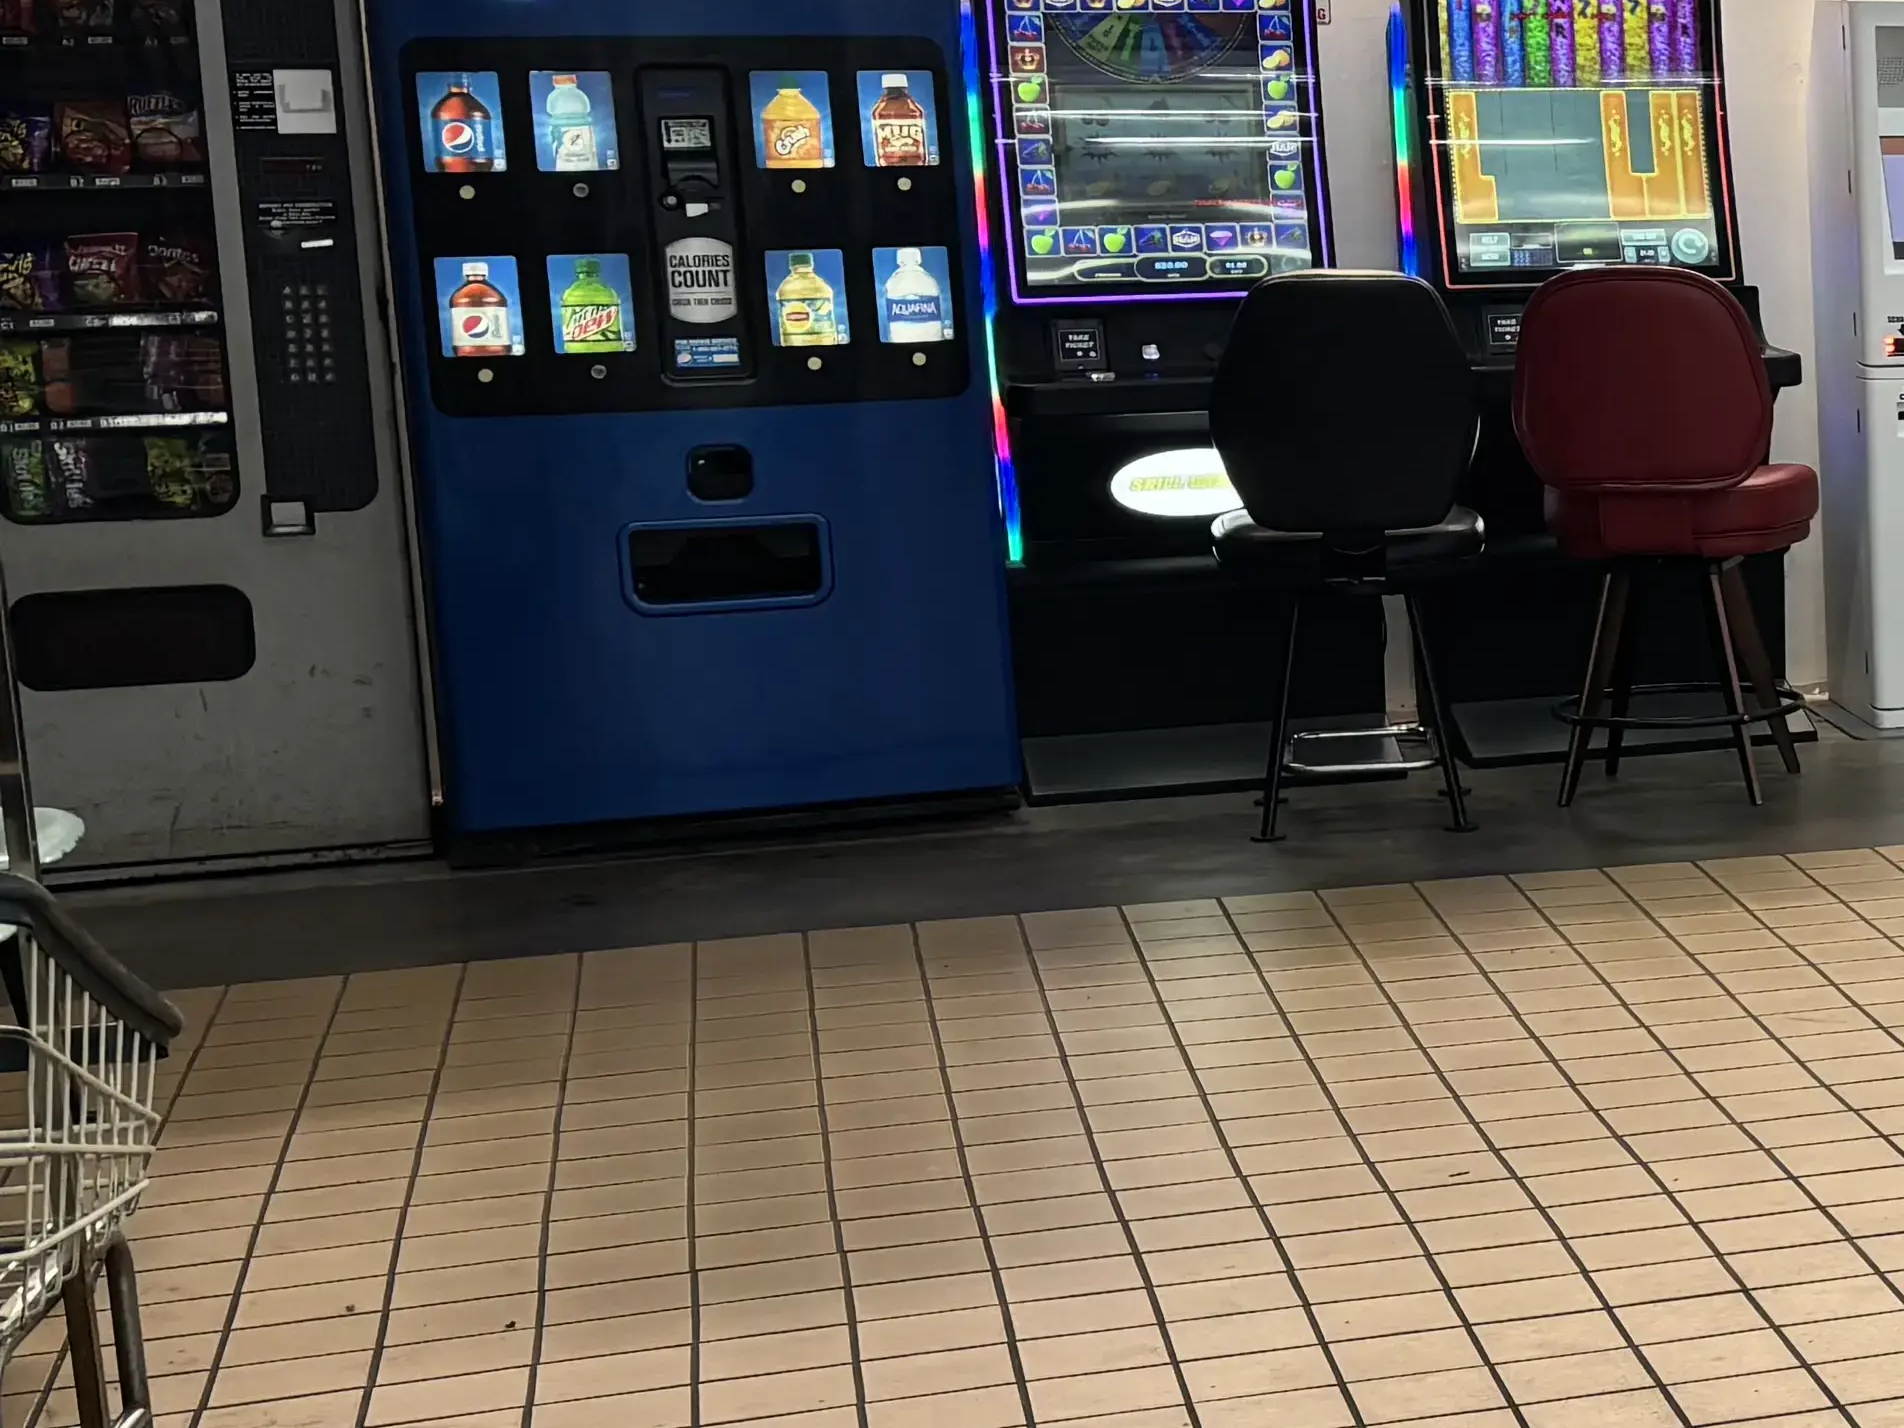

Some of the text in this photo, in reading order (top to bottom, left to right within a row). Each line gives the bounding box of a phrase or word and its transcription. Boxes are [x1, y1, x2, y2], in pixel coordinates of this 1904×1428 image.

[878, 124, 924, 140] MUG
[669, 254, 731, 268] CALORIES
[670, 269, 731, 288] COUNT
